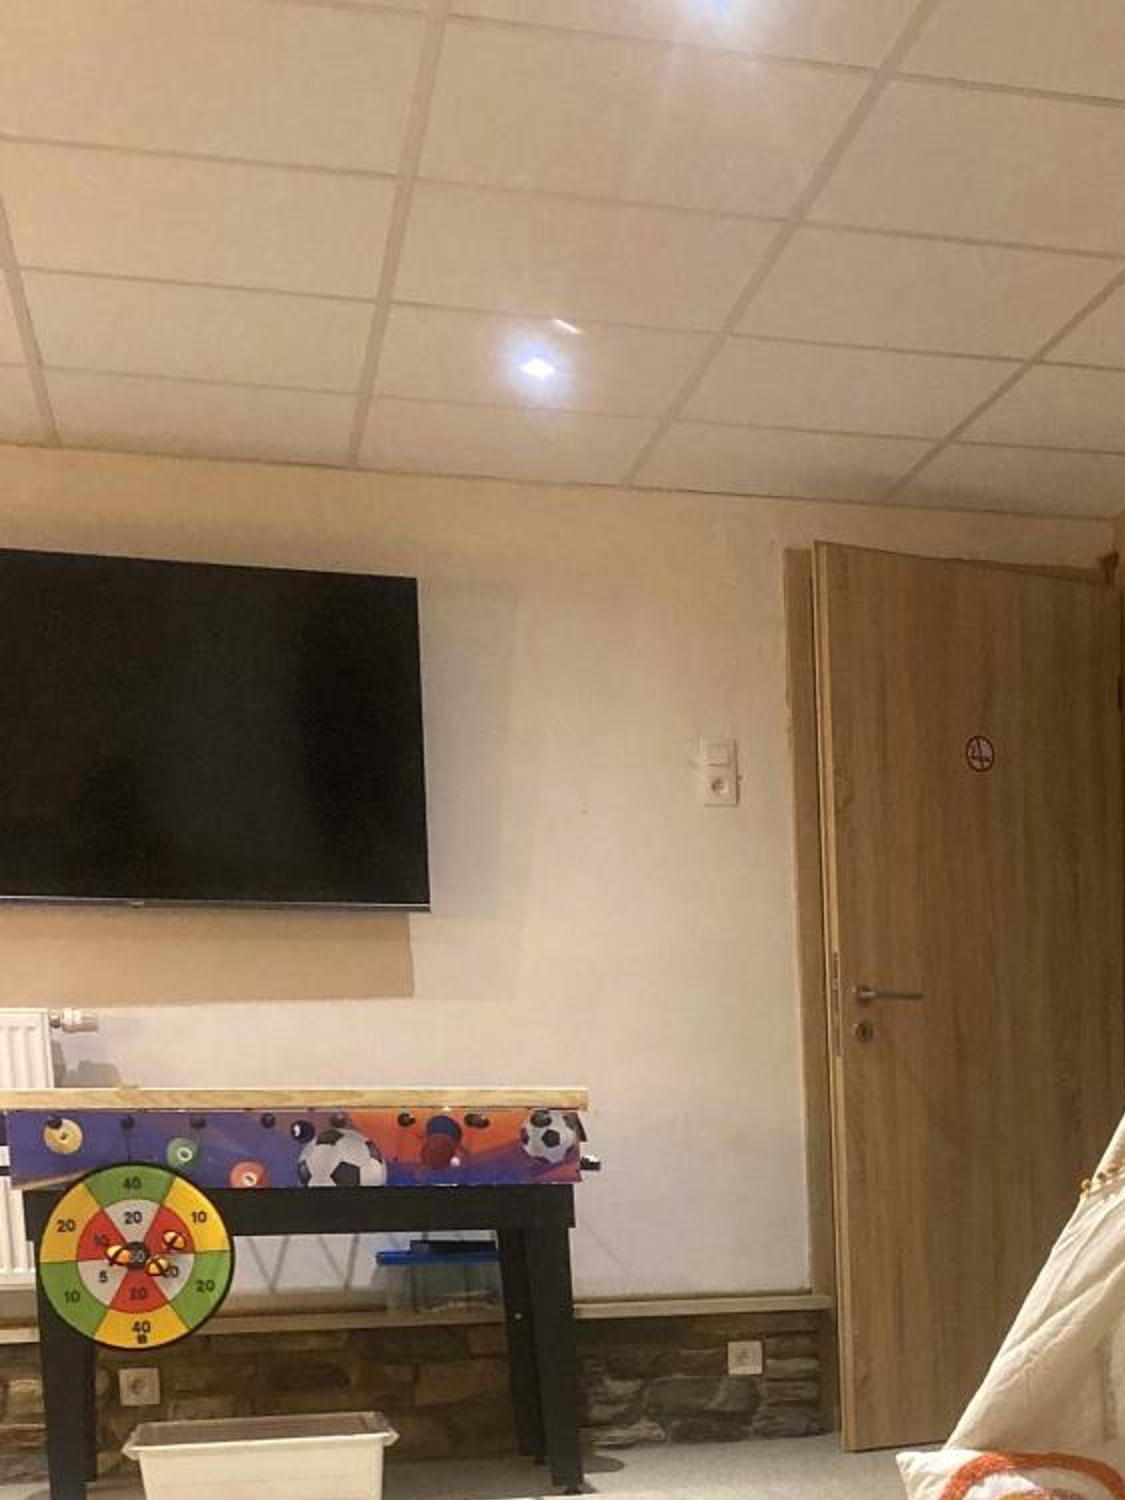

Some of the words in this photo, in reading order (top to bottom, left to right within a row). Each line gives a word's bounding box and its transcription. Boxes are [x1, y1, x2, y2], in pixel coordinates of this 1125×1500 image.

[123, 1211, 142, 1225] 20
[191, 1210, 207, 1224] 10
[56, 1219, 76, 1233] 20
[98, 1270, 108, 1283] 5
[196, 1279, 215, 1293] 20
[64, 1290, 81, 1304] 10
[131, 1320, 151, 1334] 40
